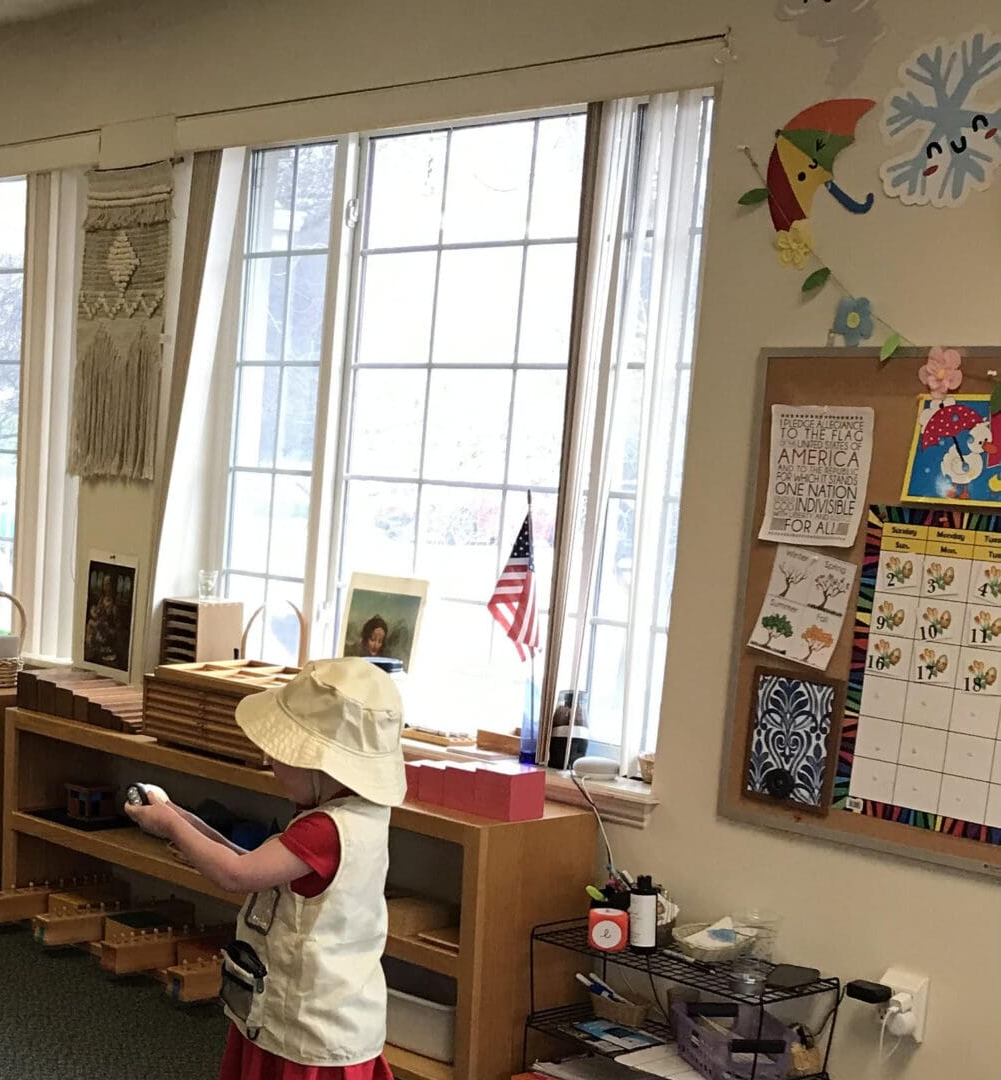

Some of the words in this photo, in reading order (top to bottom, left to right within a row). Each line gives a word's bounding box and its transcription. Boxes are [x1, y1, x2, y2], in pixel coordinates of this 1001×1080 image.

[784, 419, 814, 429] PLEDGE
[817, 420, 864, 430] ALLEGIANCE
[781, 428, 798, 439] TO
[805, 428, 826, 440] THE
[831, 429, 863, 441] FLAG
[798, 441, 822, 449] UNITED
[824, 442, 848, 450] STATES
[777, 448, 859, 467] AMERICA
[794, 474, 820, 483] WHICH
[829, 475, 858, 486] STANDS
[775, 482, 804, 496] ONE
[808, 484, 857, 499] NATION
[795, 498, 856, 515] INDIVISIBLE
[785, 519, 812, 533] FOR
[816, 522, 836, 535] ALL
[891, 526, 917, 537] Sunday
[936, 531, 965, 542] Monday
[895, 541, 910, 550] Sun.
[940, 546, 957, 555] Mon.
[886, 572, 895, 587] 2
[927, 578, 936, 594] 3
[978, 582, 989, 597] 4
[876, 615, 886, 630] 9
[919, 624, 938, 640] 10
[971, 628, 987, 644] 11
[867, 655, 885, 671] 16
[918, 665, 936, 680] 17
[964, 677, 982, 692] 18
